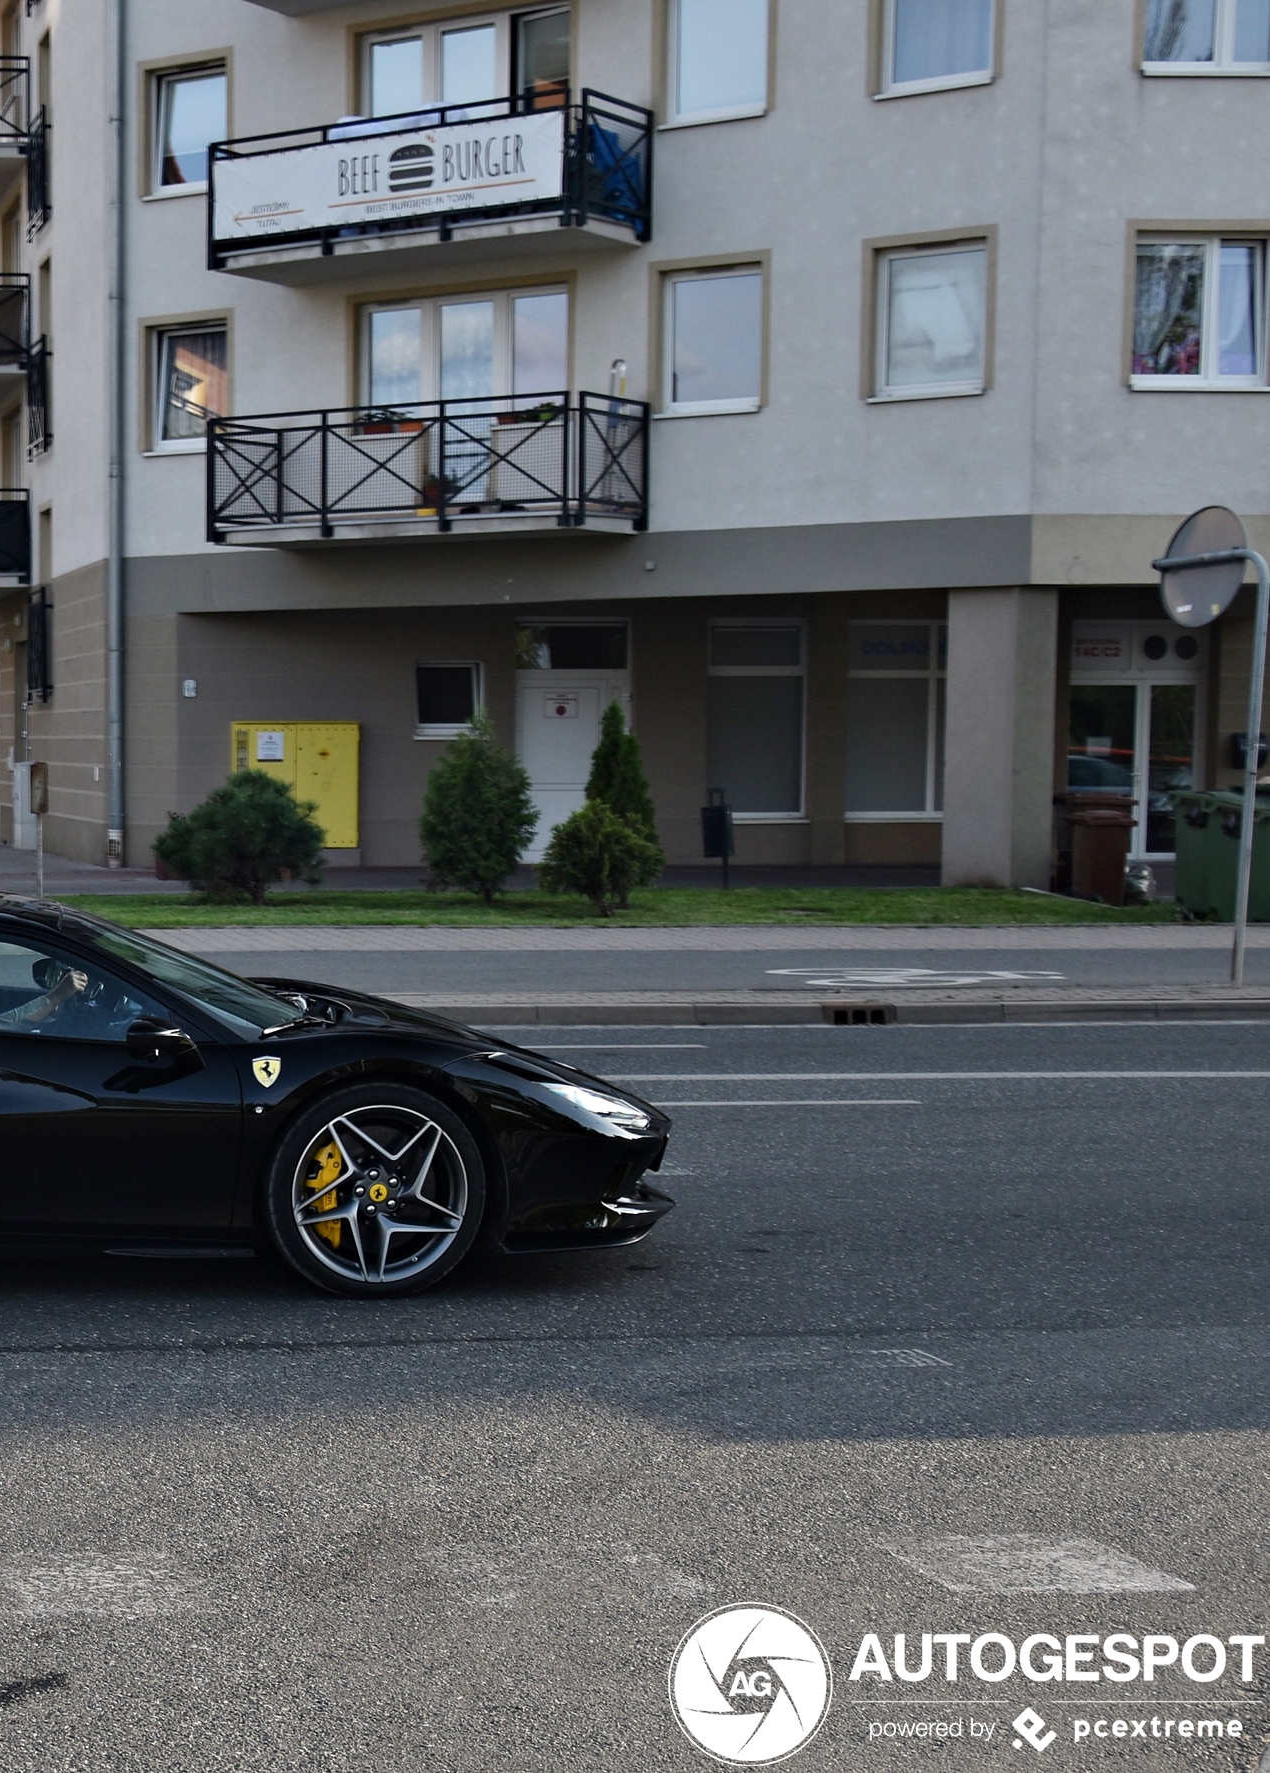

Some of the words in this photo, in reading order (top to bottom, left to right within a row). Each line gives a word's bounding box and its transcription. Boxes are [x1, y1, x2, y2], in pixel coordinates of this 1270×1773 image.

[338, 154, 380, 197] BEEF
[442, 134, 525, 183] BURGER
[364, 202, 388, 214] BEST
[389, 198, 432, 212] BURGERS
[446, 193, 475, 204] TOWN
